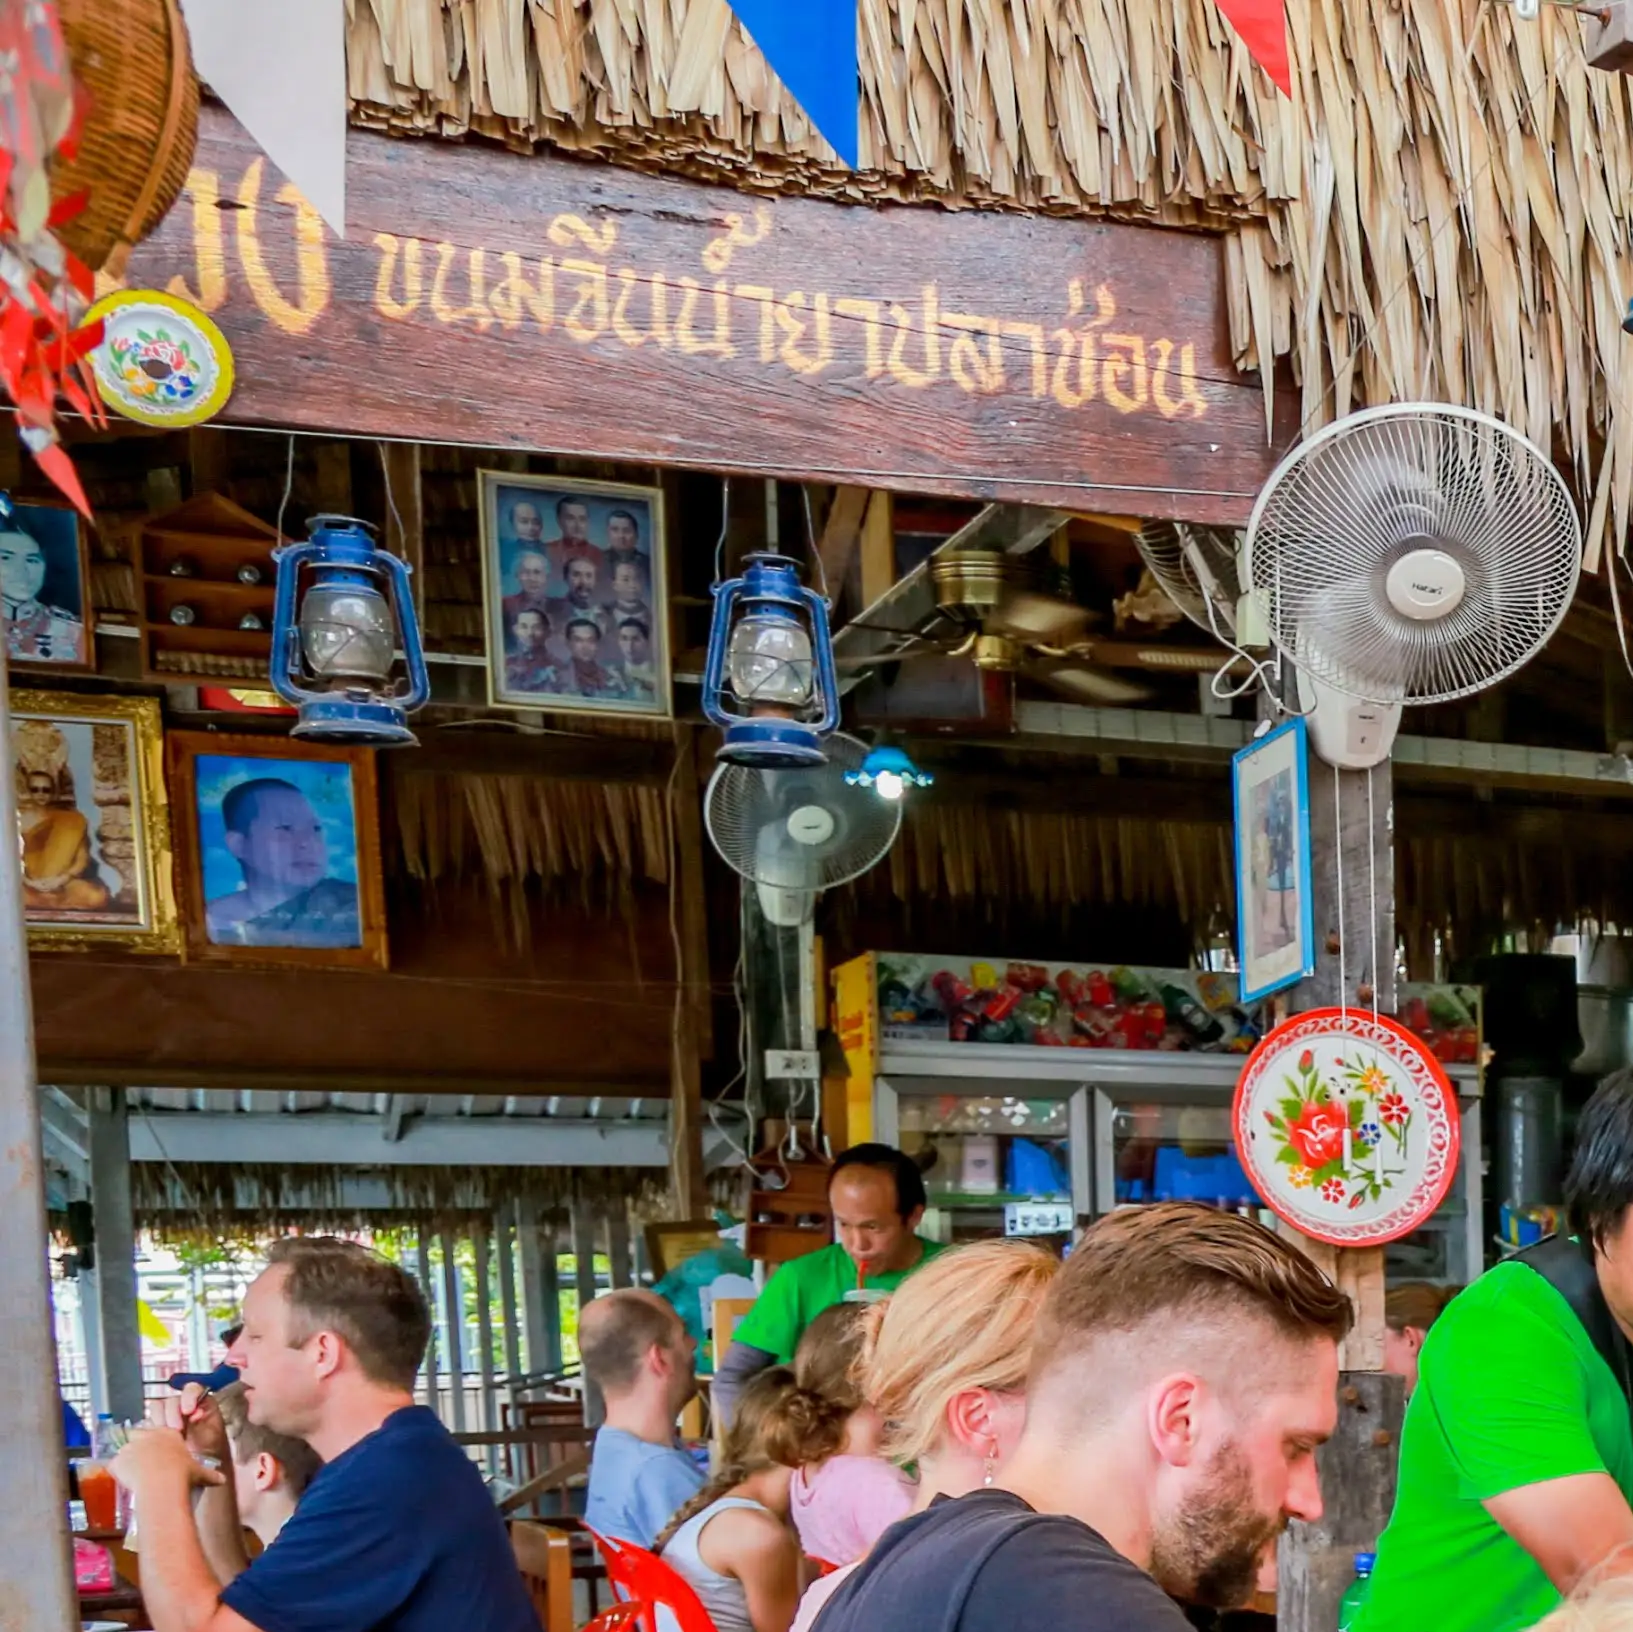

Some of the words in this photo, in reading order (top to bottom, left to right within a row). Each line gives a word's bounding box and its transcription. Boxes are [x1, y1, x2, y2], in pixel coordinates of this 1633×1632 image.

[372, 207, 1208, 419] ขนมจีนน้ำยาปลาช่อน
